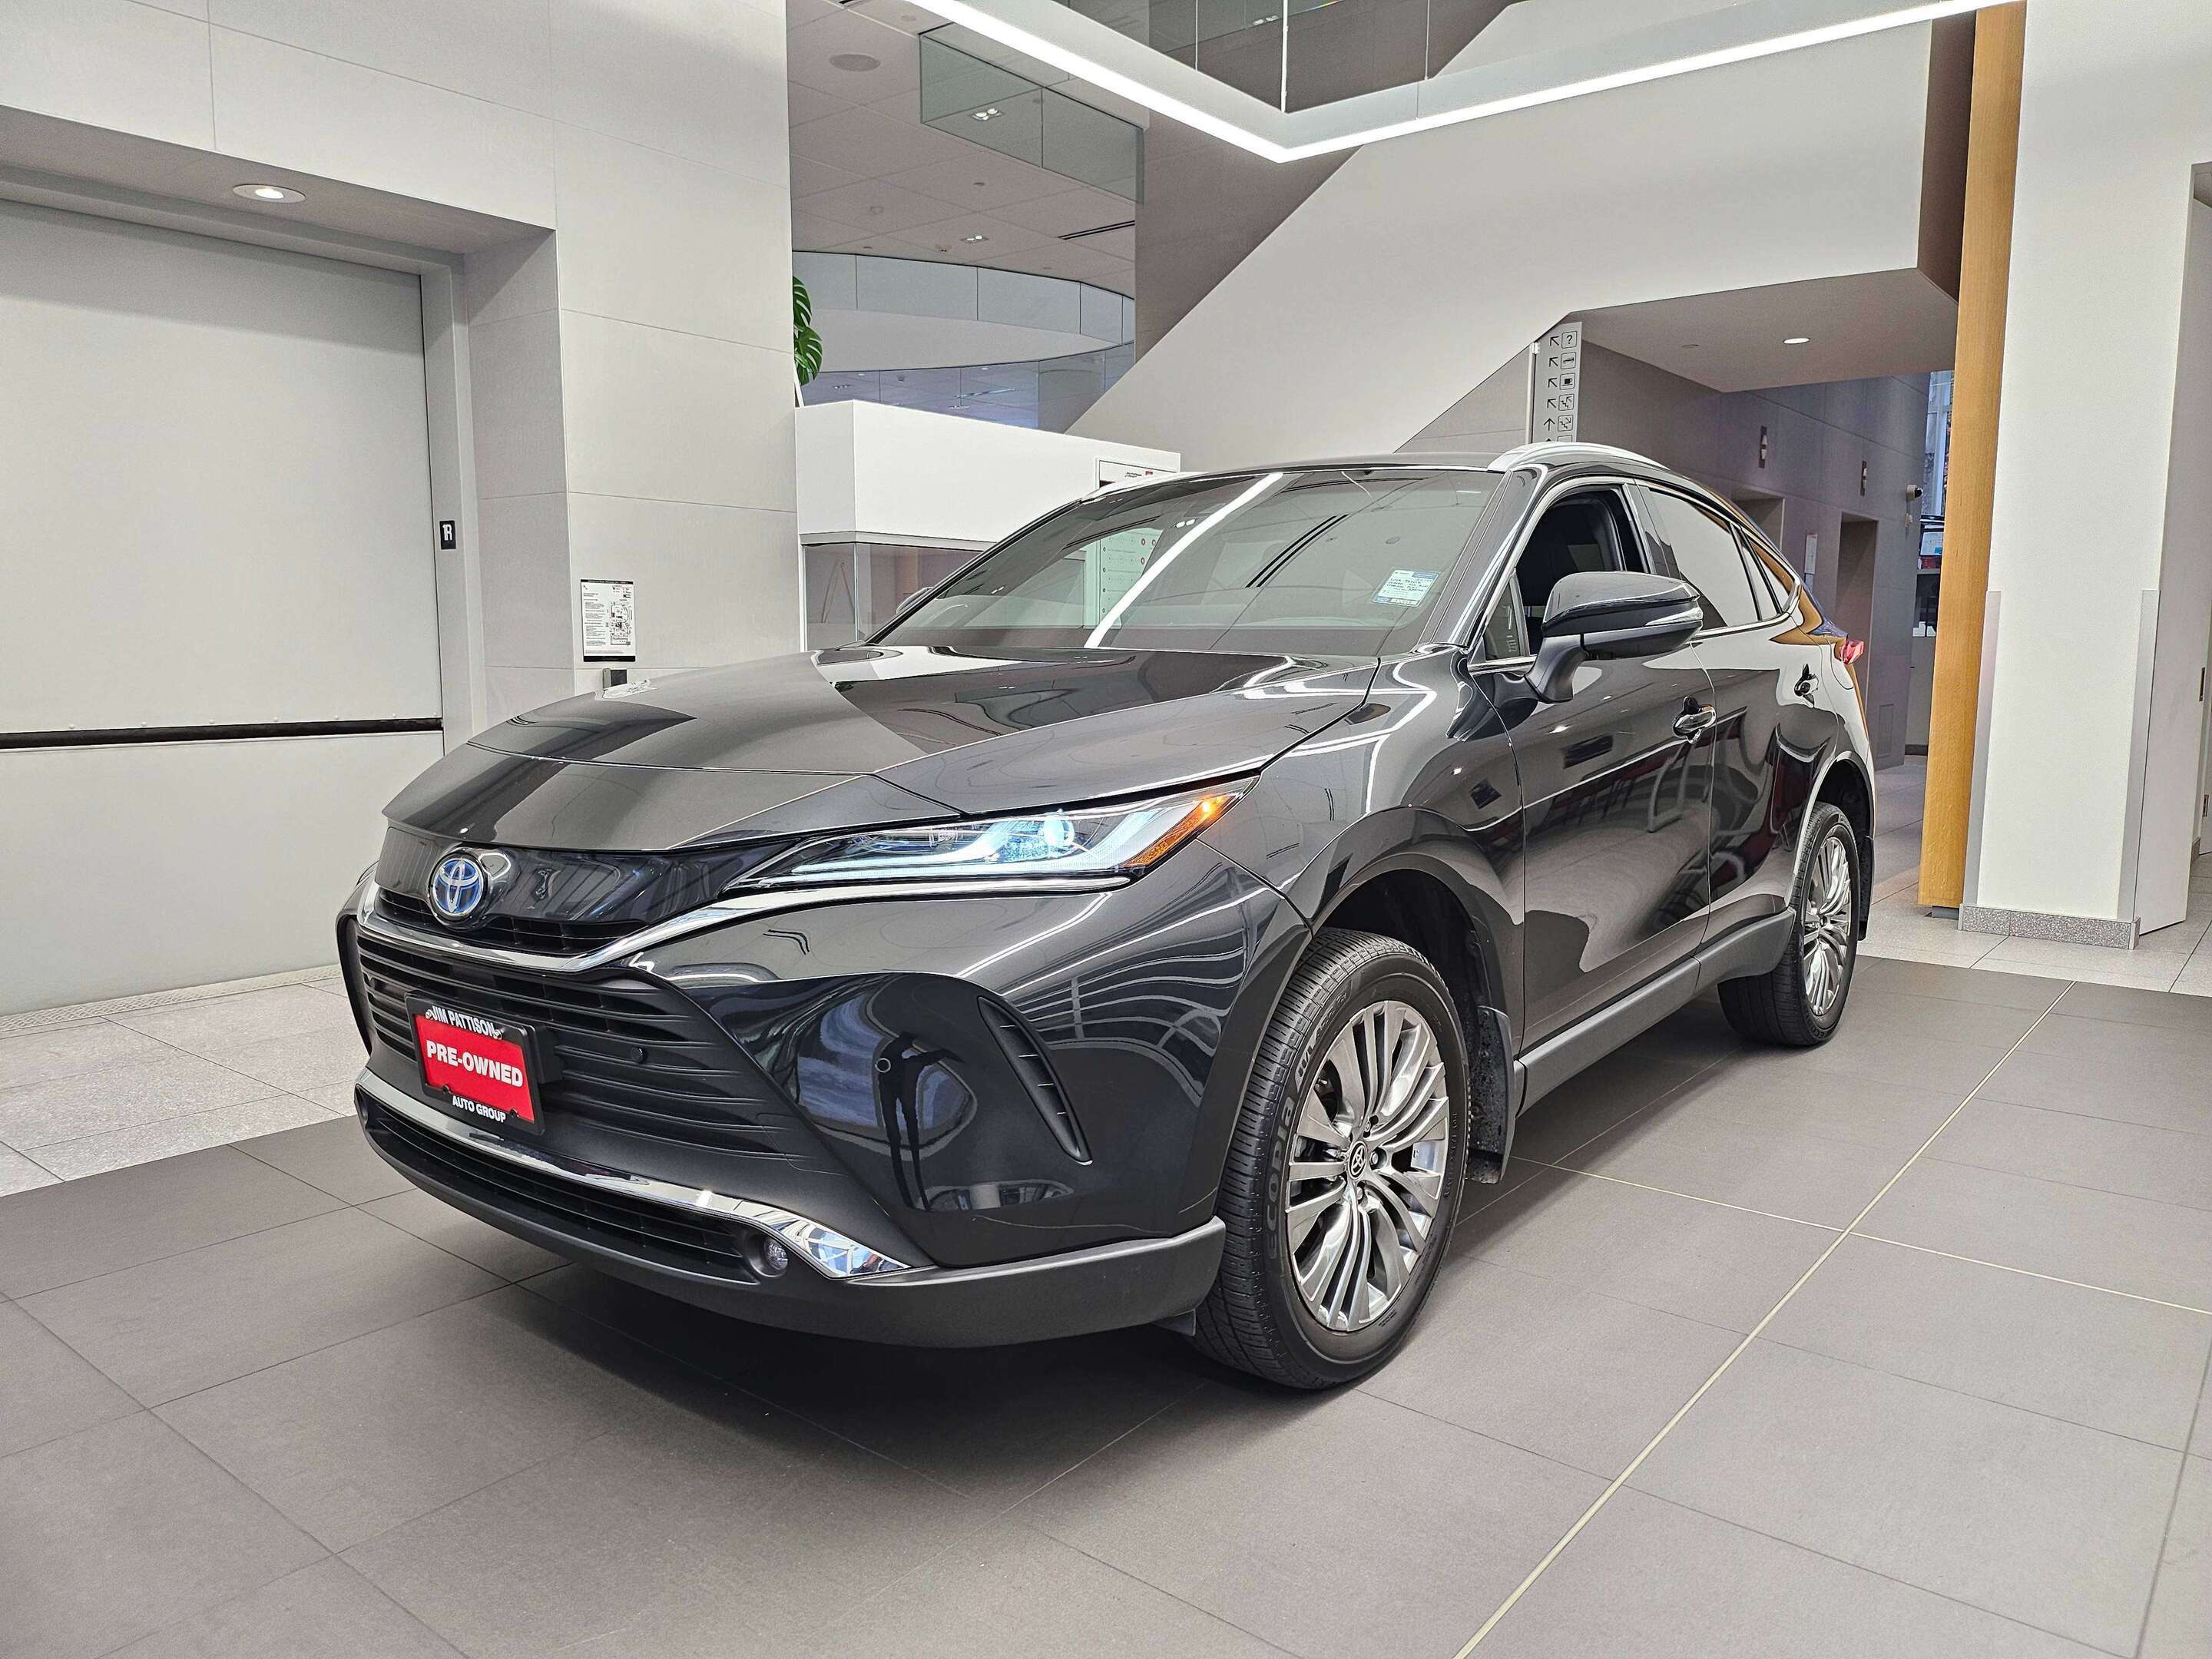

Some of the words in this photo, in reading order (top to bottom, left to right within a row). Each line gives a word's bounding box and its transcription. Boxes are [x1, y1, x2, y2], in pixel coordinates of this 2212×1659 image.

[429, 1005, 449, 1025] JIM
[447, 1009, 497, 1038] PATTISON
[426, 1039, 524, 1087] PRE-OWNED
[452, 1095, 475, 1112] AUTO
[476, 1103, 506, 1123] GROUP
